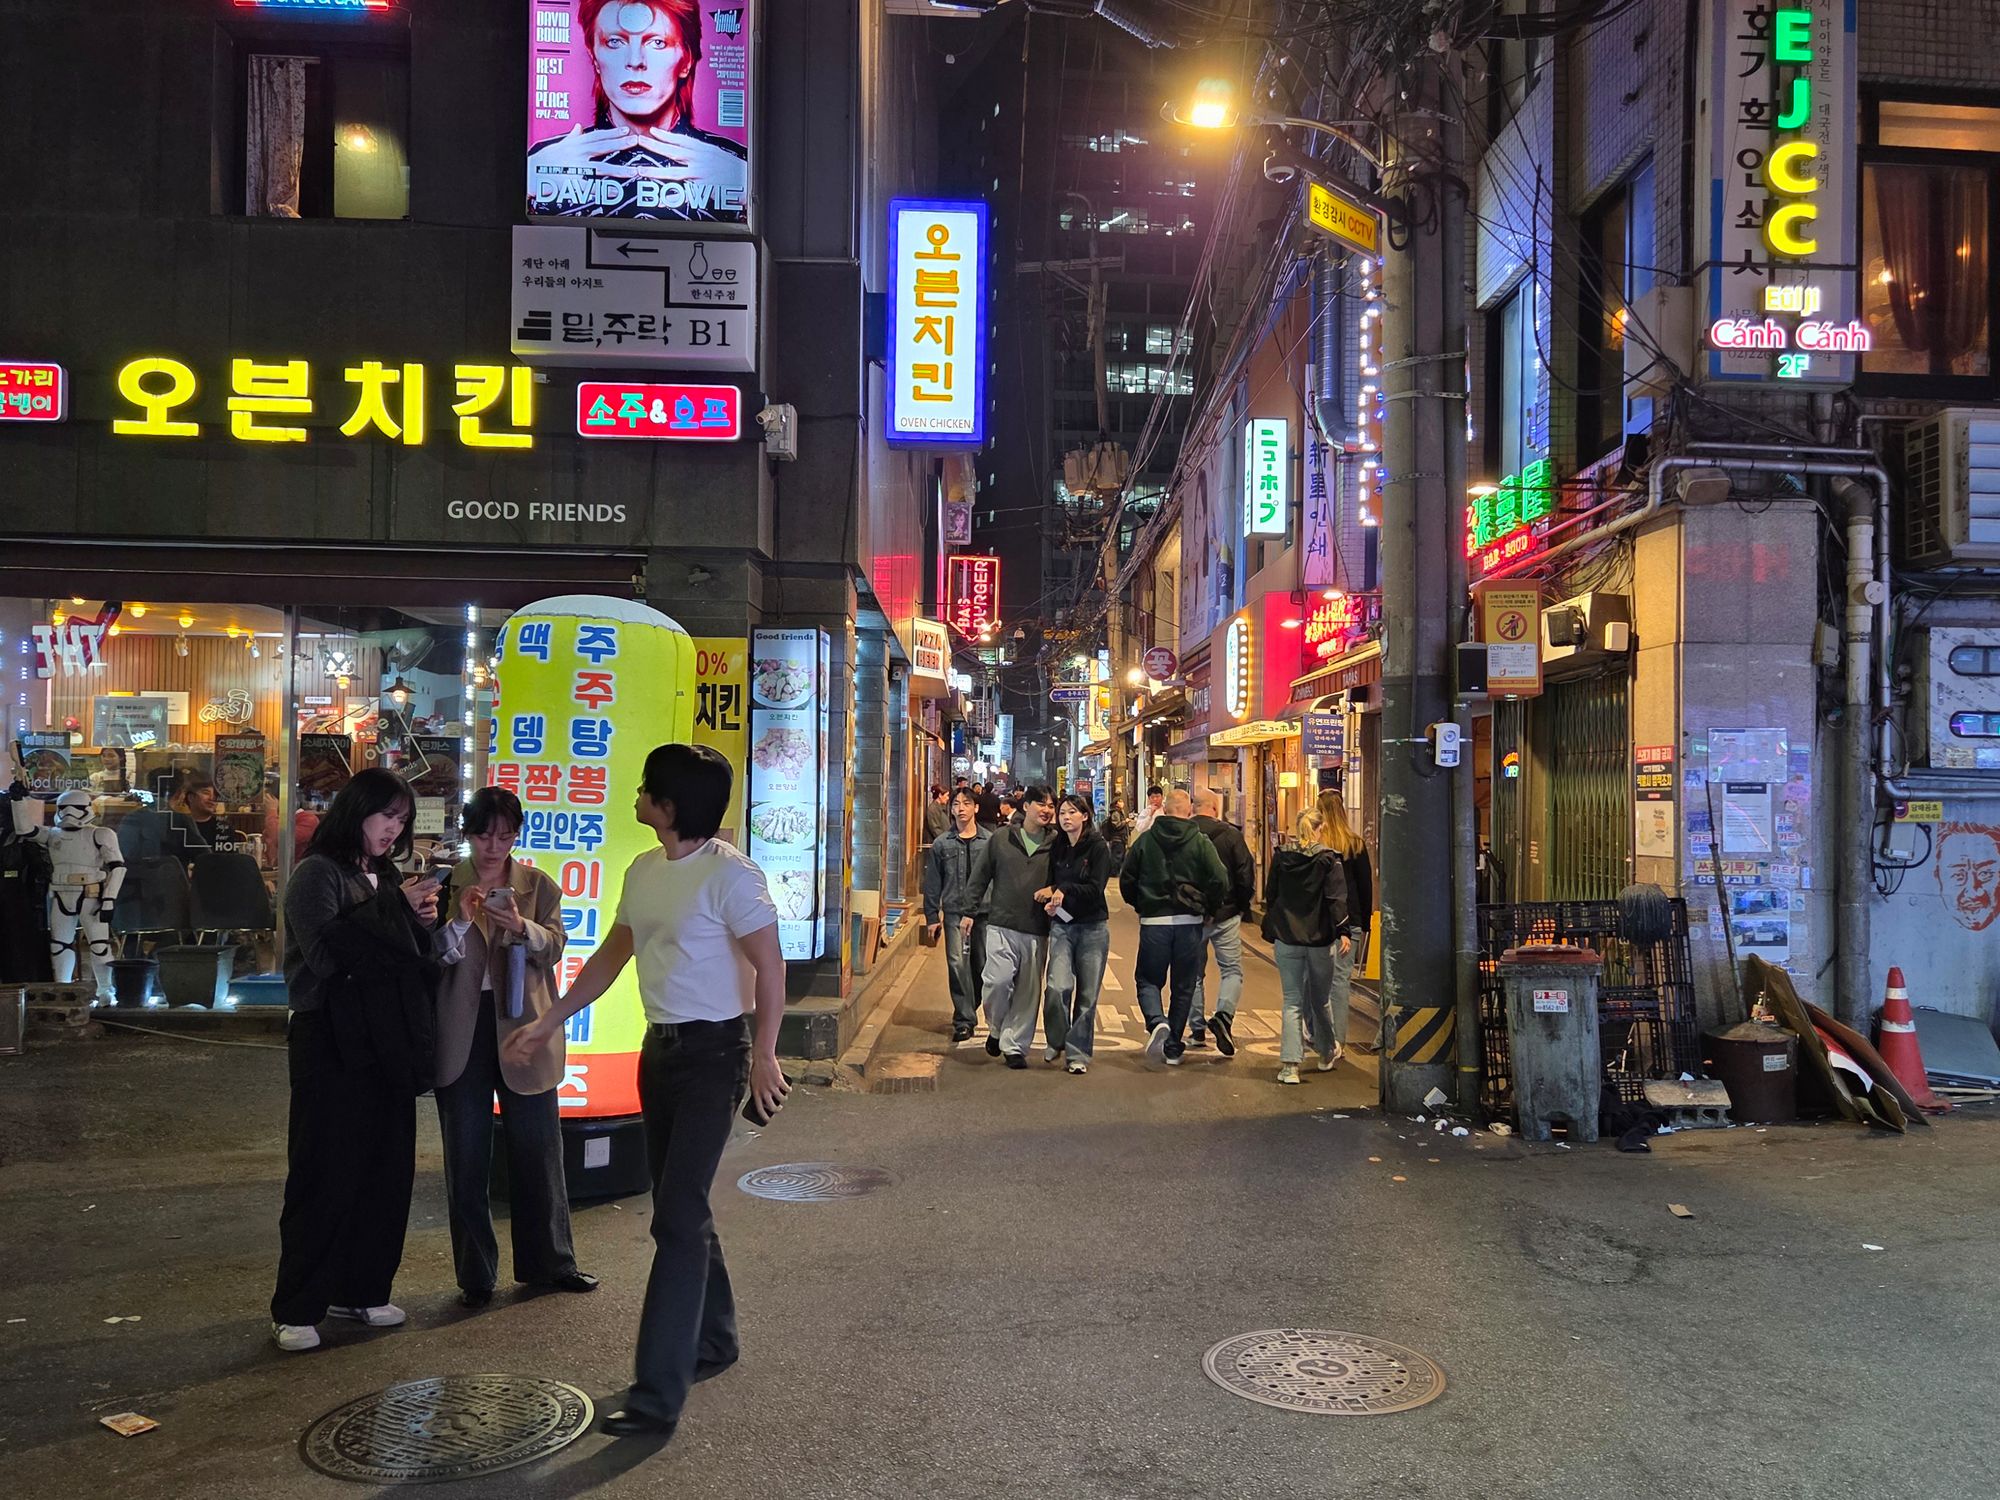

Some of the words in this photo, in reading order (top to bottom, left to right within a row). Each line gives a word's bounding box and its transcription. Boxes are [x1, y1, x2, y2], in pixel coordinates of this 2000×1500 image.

[537, 11, 570, 28] DAVID
[537, 27, 570, 43] BOWIE
[536, 58, 564, 74] REST
[536, 74, 548, 91] IN
[536, 91, 570, 108] PEACE
[536, 179, 625, 206] DAVID
[636, 180, 745, 211] BOWIE
[1314, 197, 1346, 229] 환경감시
[1348, 216, 1373, 241] CCTV
[522, 258, 544, 270] 계단
[548, 258, 570, 271] 아래
[522, 276, 566, 288] 우리들의
[570, 277, 604, 288] 아지트
[691, 289, 736, 301] 한식주점
[912, 223, 961, 401] 오븐치킨
[689, 319, 731, 347] B1
[1777, 354, 1810, 378] 2F
[113, 357, 534, 448] 오븐치킨
[586, 392, 730, 429] 소주&호프
[900, 417, 927, 429] OVEN
[929, 417, 971, 429] CHICKEN
[447, 501, 520, 520] GOOD
[529, 502, 626, 523] FRIENDS
[756, 633, 779, 641] Good
[781, 633, 814, 641] friends
